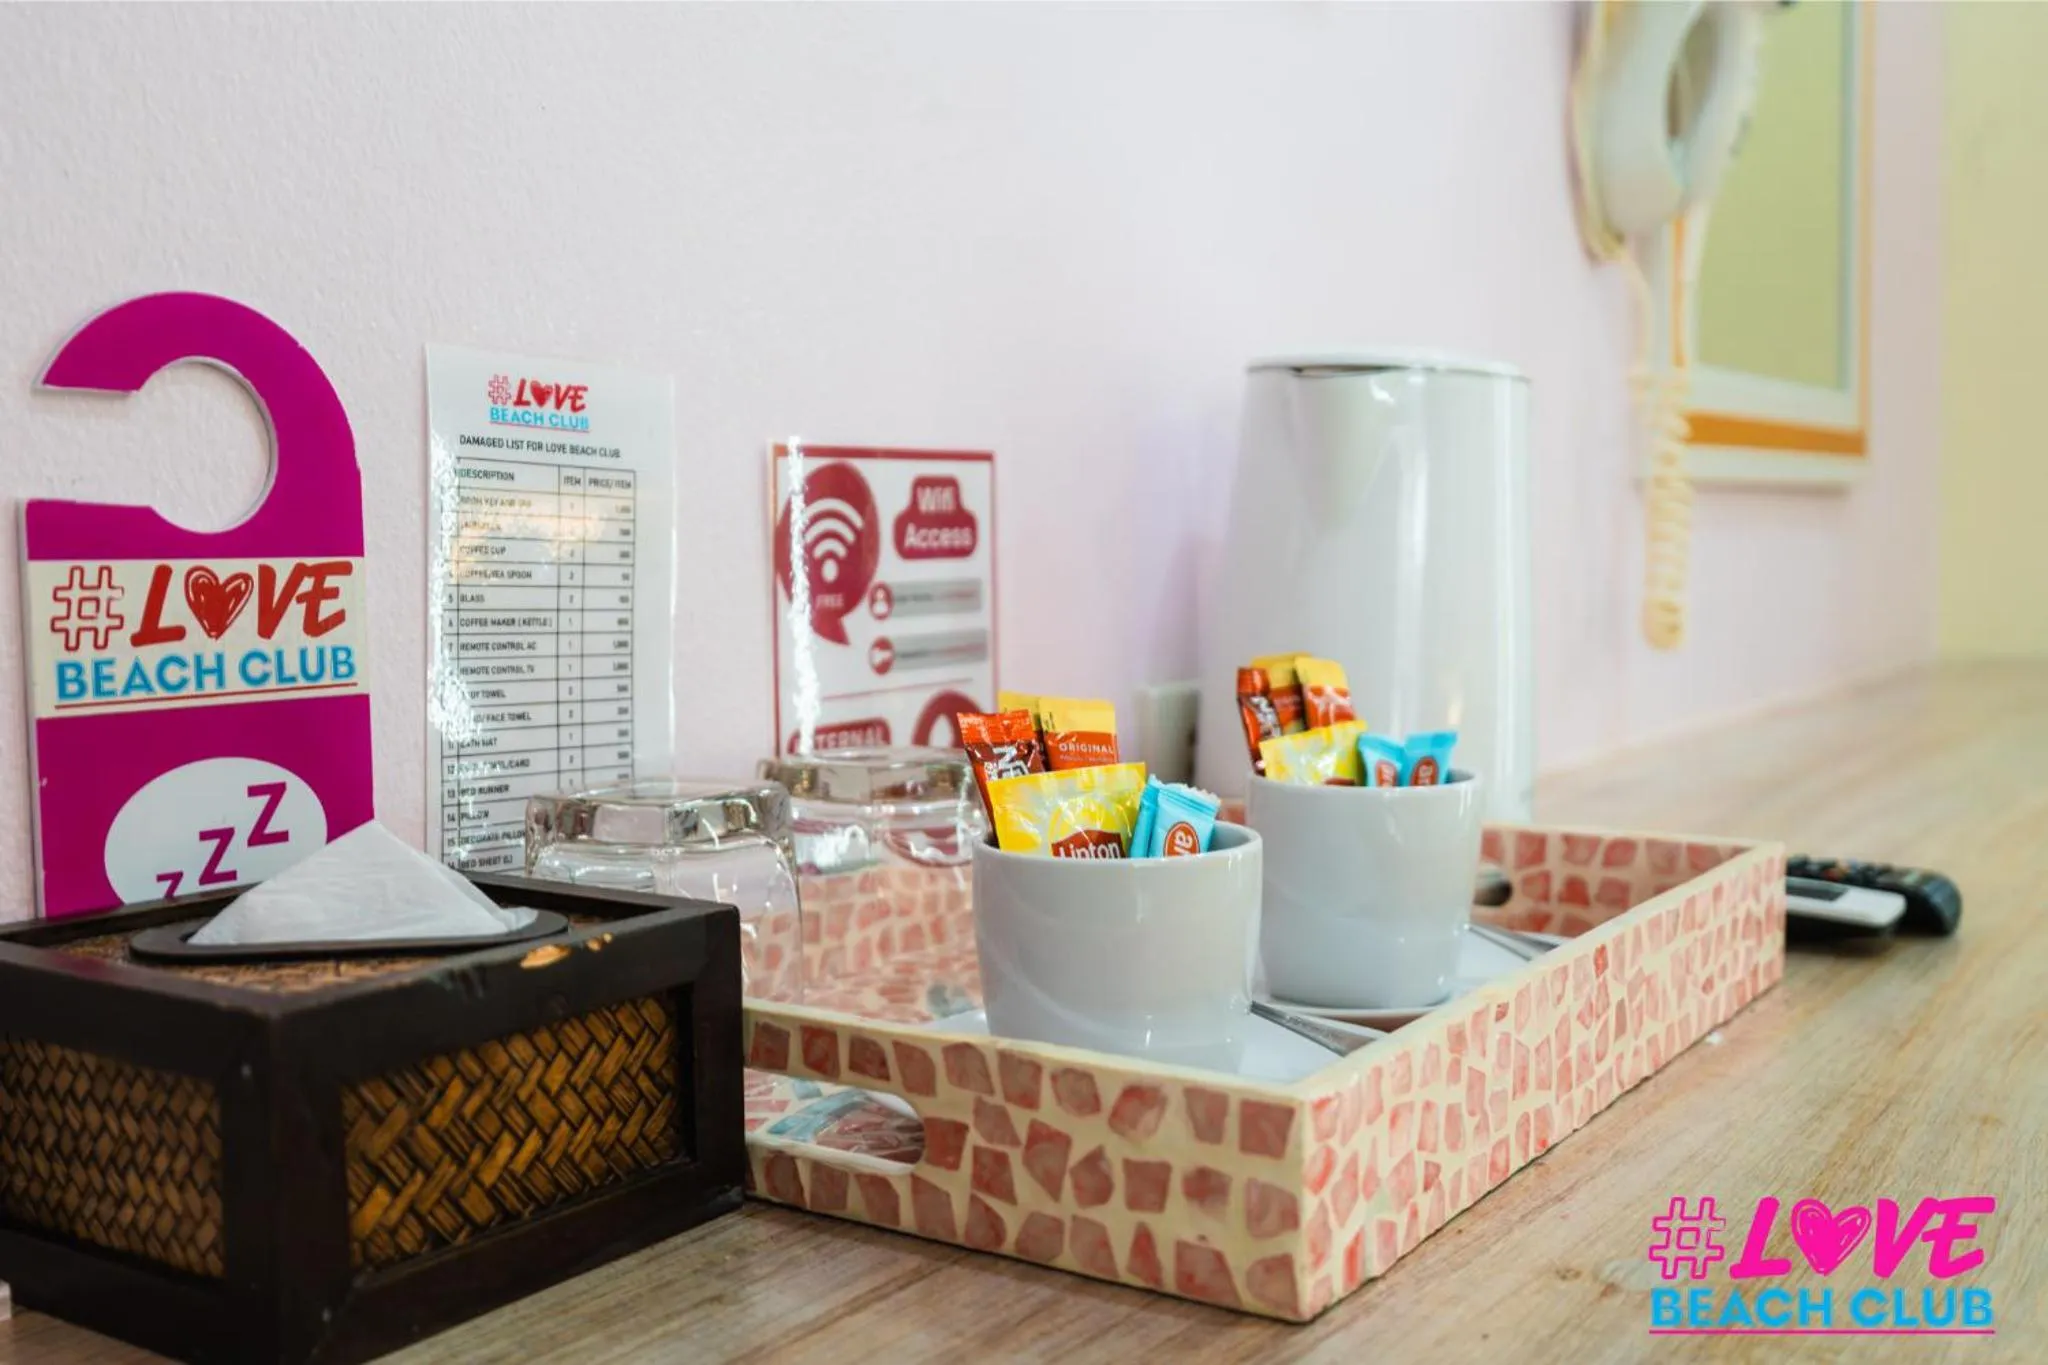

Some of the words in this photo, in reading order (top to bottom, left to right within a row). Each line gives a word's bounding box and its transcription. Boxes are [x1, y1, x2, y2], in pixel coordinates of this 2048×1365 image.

[490, 407, 544, 425] BEACH
[549, 415, 589, 430] CLUB
[460, 435, 504, 449] DAMAGED
[506, 438, 524, 450] LIST
[527, 441, 543, 452] FOR
[546, 443, 567, 454] LOVE
[570, 445, 597, 456] BEACH
[599, 447, 621, 458] CLUB
[460, 468, 515, 481] DESCRIPTION
[904, 522, 973, 549] Access
[460, 617, 488, 627] COFFEE
[491, 617, 515, 627] MAKER
[460, 642, 489, 652] REMOTE
[491, 642, 525, 652] CONTROL
[55, 652, 227, 700] BEACH
[238, 645, 356, 687] CLUB
[460, 665, 489, 675] REMOTE
[491, 665, 524, 675] CONTROL
[507, 712, 531, 722] TOWEL
[1059, 742, 1113, 754] ORIGINAL
[478, 785, 509, 796] RUNNER
[1059, 842, 1121, 859] Lipton
